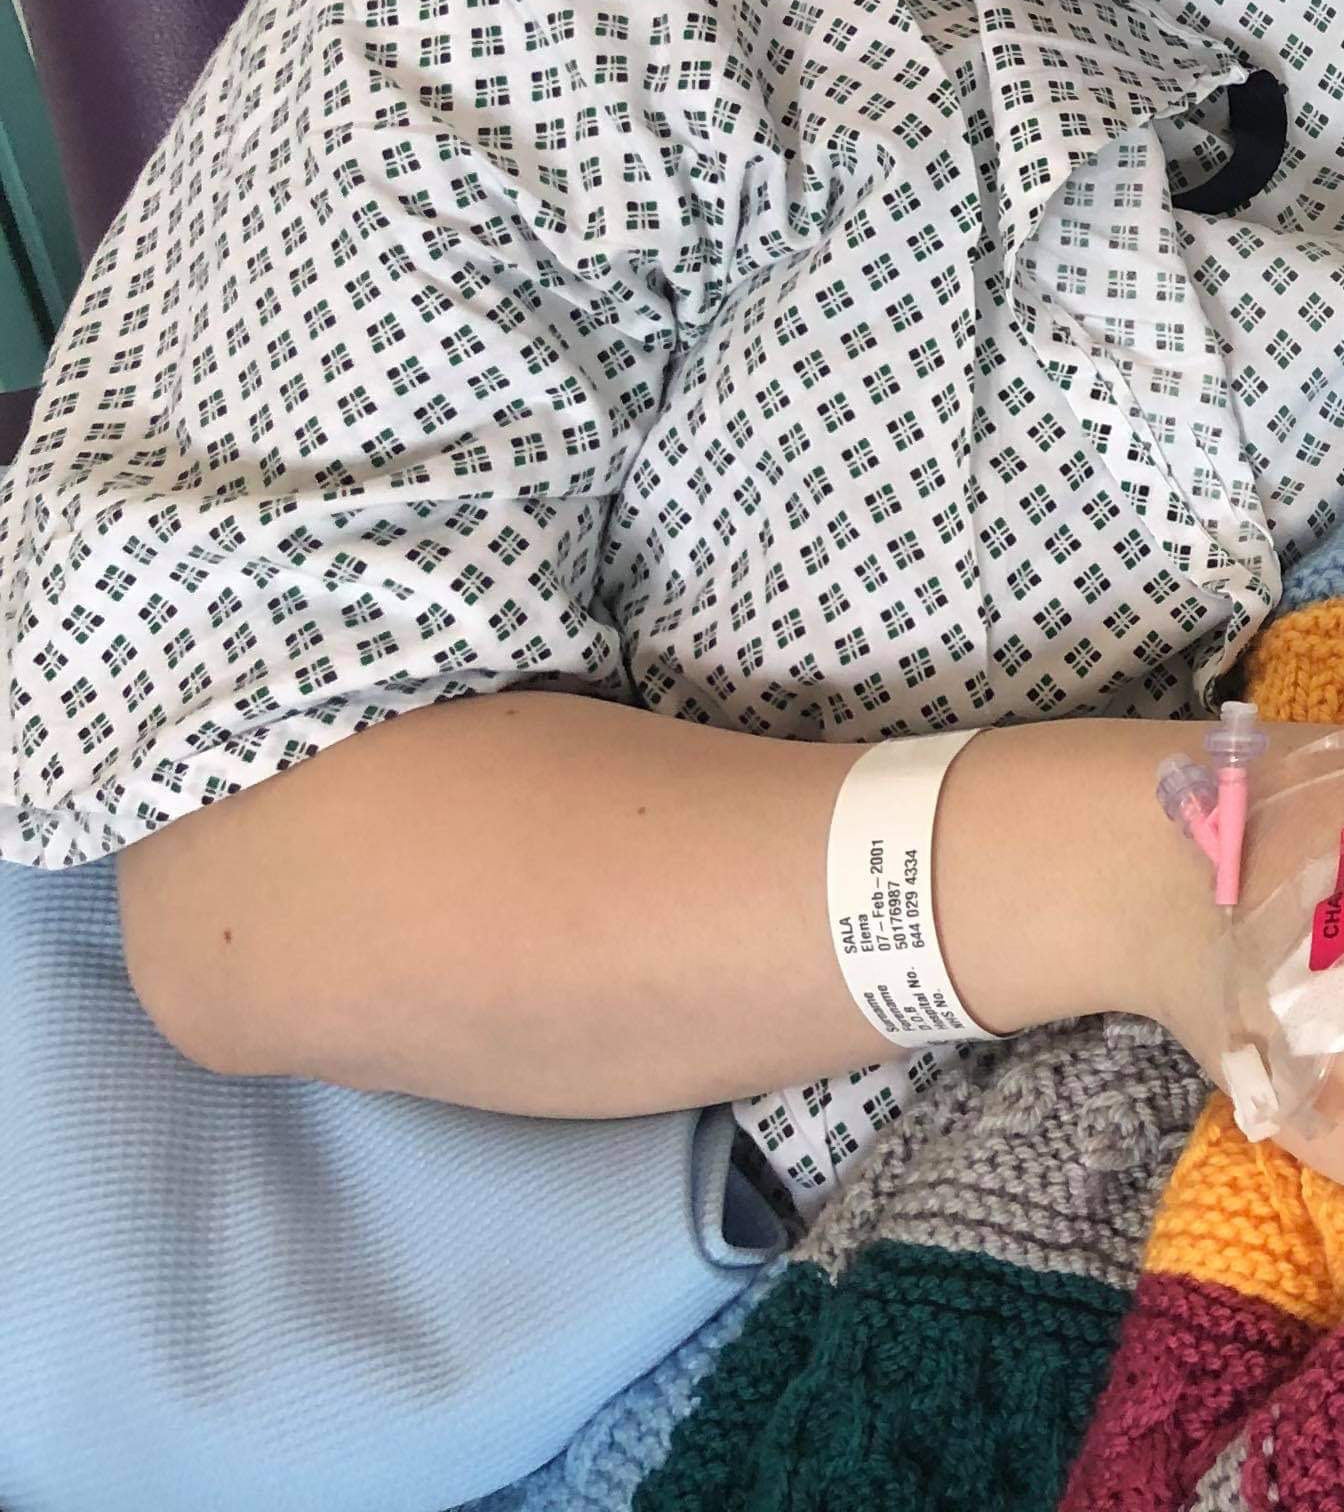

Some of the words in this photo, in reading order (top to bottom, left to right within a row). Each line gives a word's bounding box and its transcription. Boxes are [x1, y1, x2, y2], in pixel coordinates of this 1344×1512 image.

[904, 849, 918, 885] 4334
[888, 881, 908, 950] 50176987
[905, 891, 919, 918] 029
[839, 916, 857, 954] SALA
[858, 913, 874, 953] Elena
[912, 923, 925, 948] 644
[906, 966, 921, 988] No.
[864, 992, 899, 1032] Surname
[877, 985, 915, 1031] Forename
[914, 993, 948, 1031] Hospital
[941, 1011, 965, 1029] NHS
